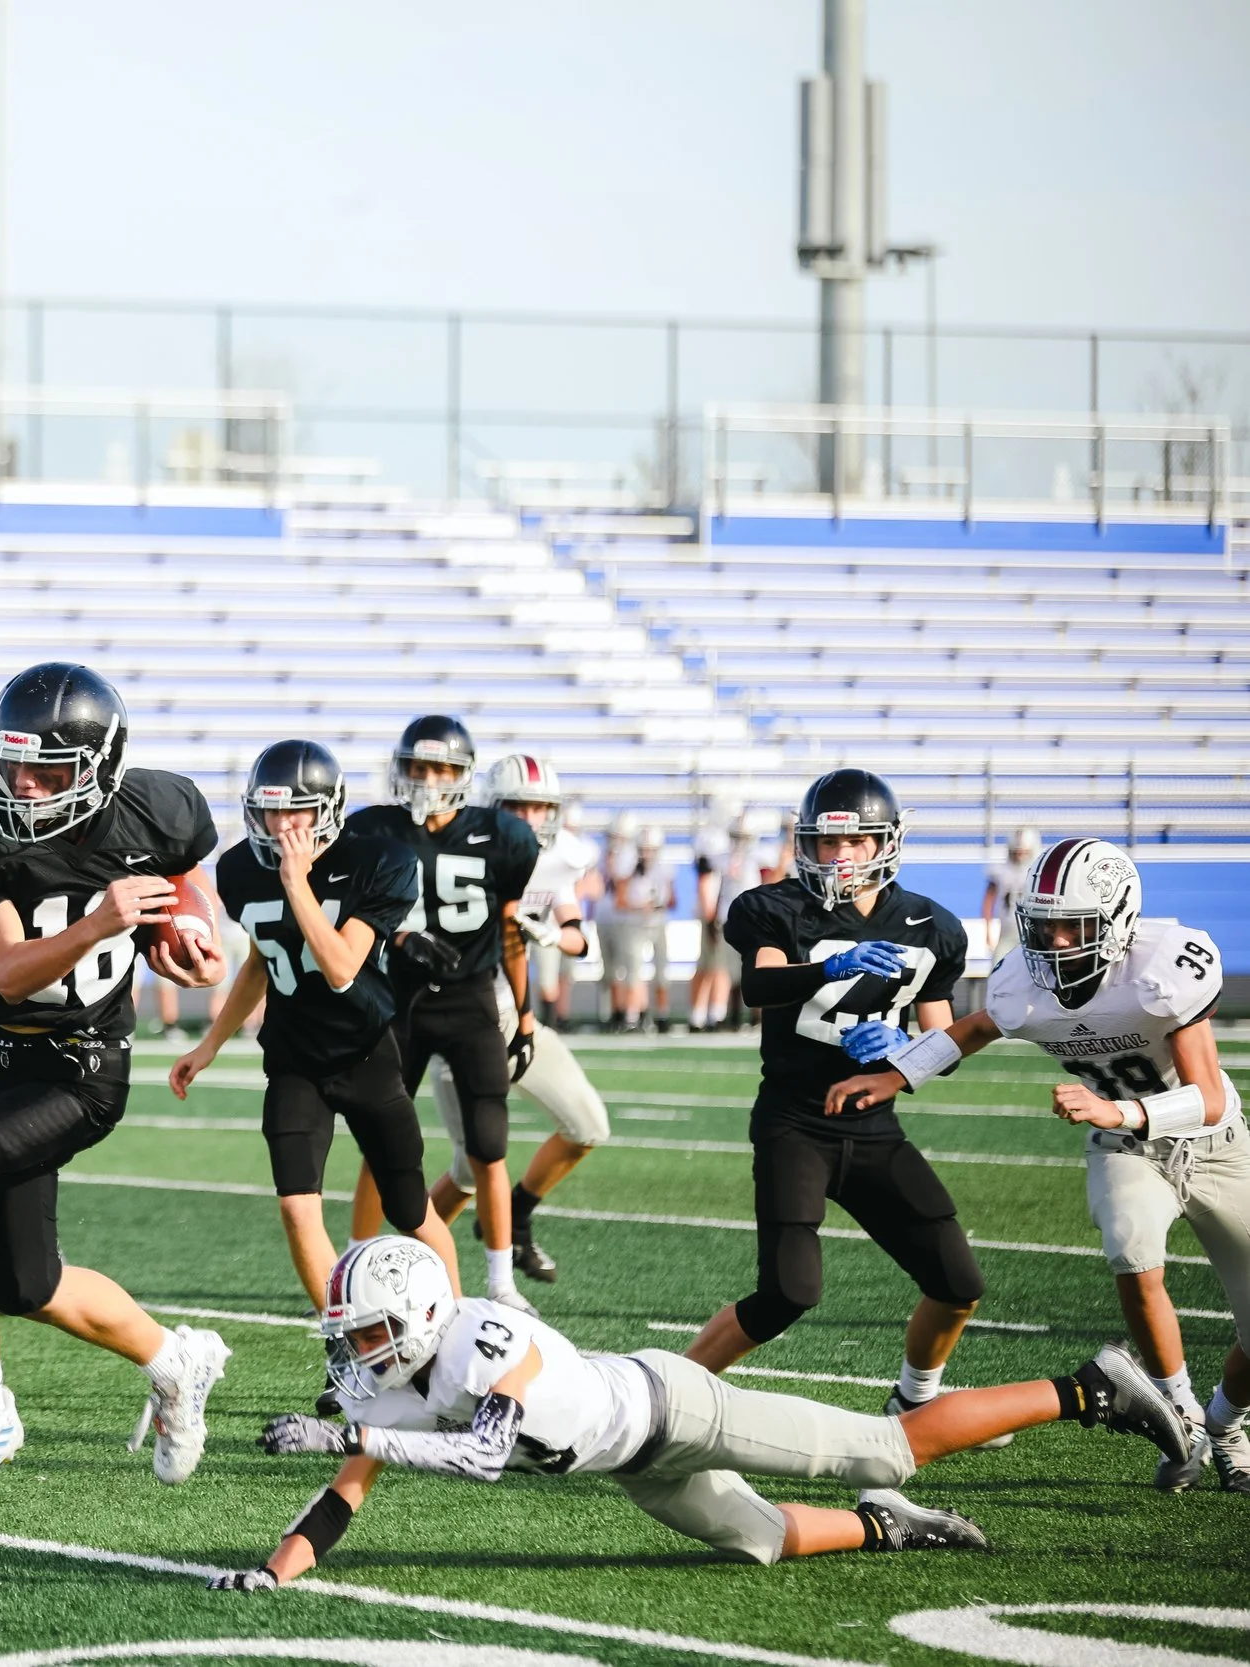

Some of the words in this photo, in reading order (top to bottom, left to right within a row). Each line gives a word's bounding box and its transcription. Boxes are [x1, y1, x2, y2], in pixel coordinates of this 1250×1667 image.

[4, 733, 29, 745] Riddell
[1175, 940, 1215, 981] 39
[473, 1319, 514, 1362] 43
